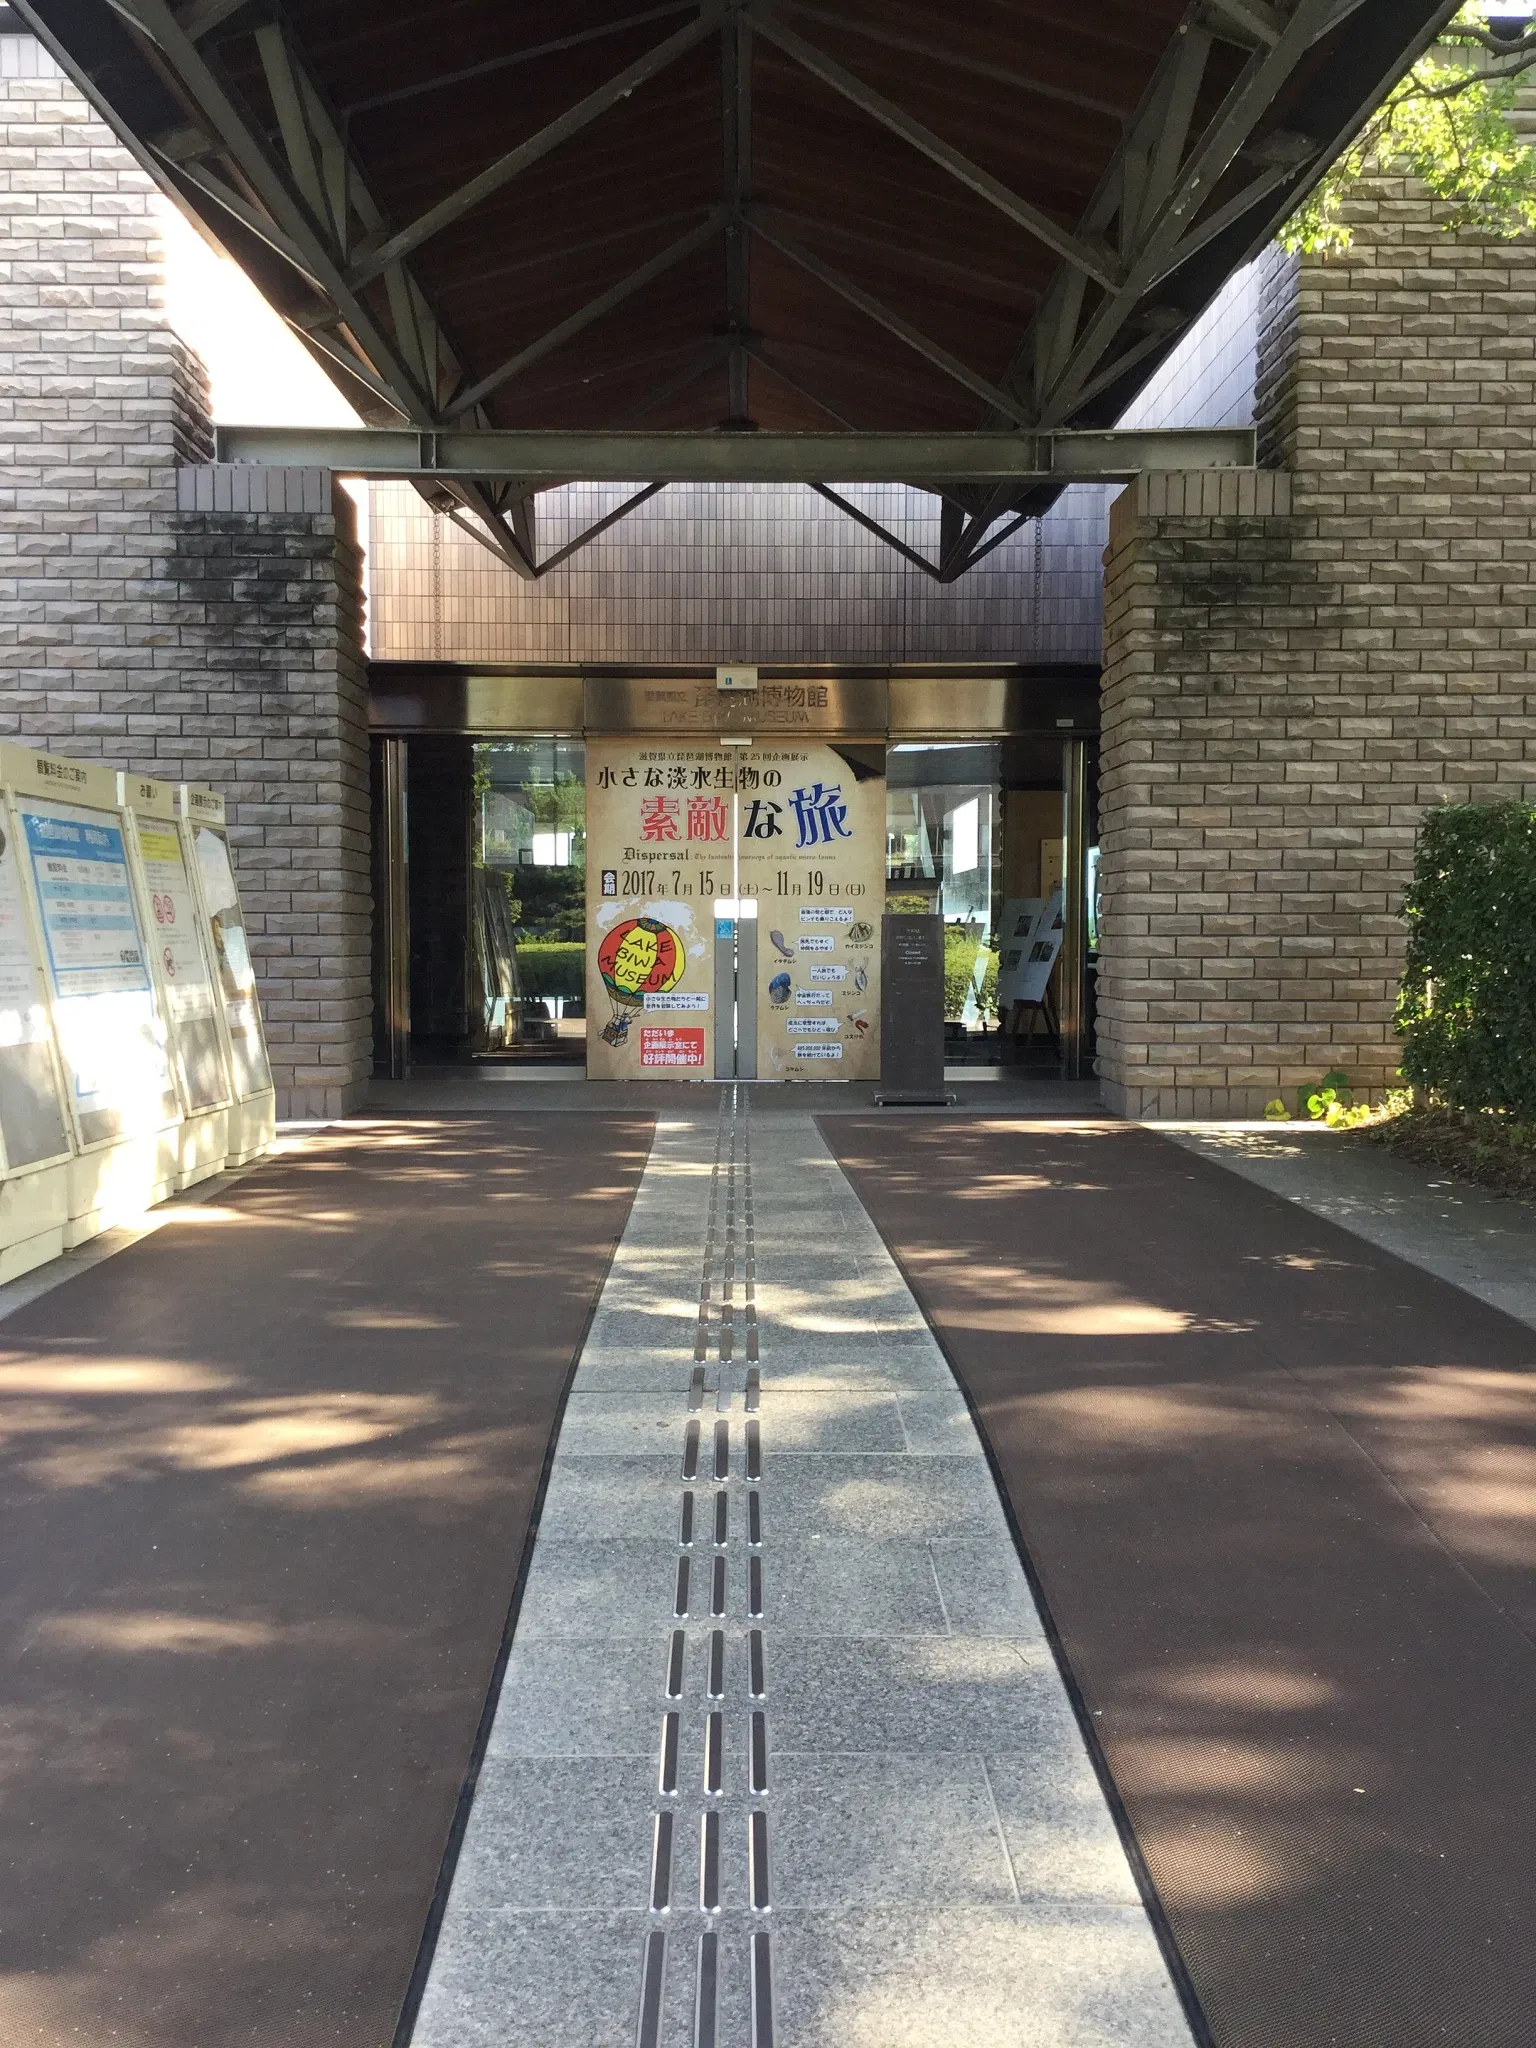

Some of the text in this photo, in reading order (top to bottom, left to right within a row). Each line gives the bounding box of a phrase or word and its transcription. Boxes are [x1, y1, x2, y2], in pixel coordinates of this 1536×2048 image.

[596, 766, 782, 790] 小さな淡水生物の
[638, 783, 853, 849] 素敵な旅
[604, 872, 615, 895] 会期
[620, 930, 673, 953] LAKE
[615, 946, 666, 968] BIWA
[601, 955, 676, 985] MUSEUM
[643, 1029, 675, 1037] ただいま
[643, 1041, 698, 1050] 企画展示室にて
